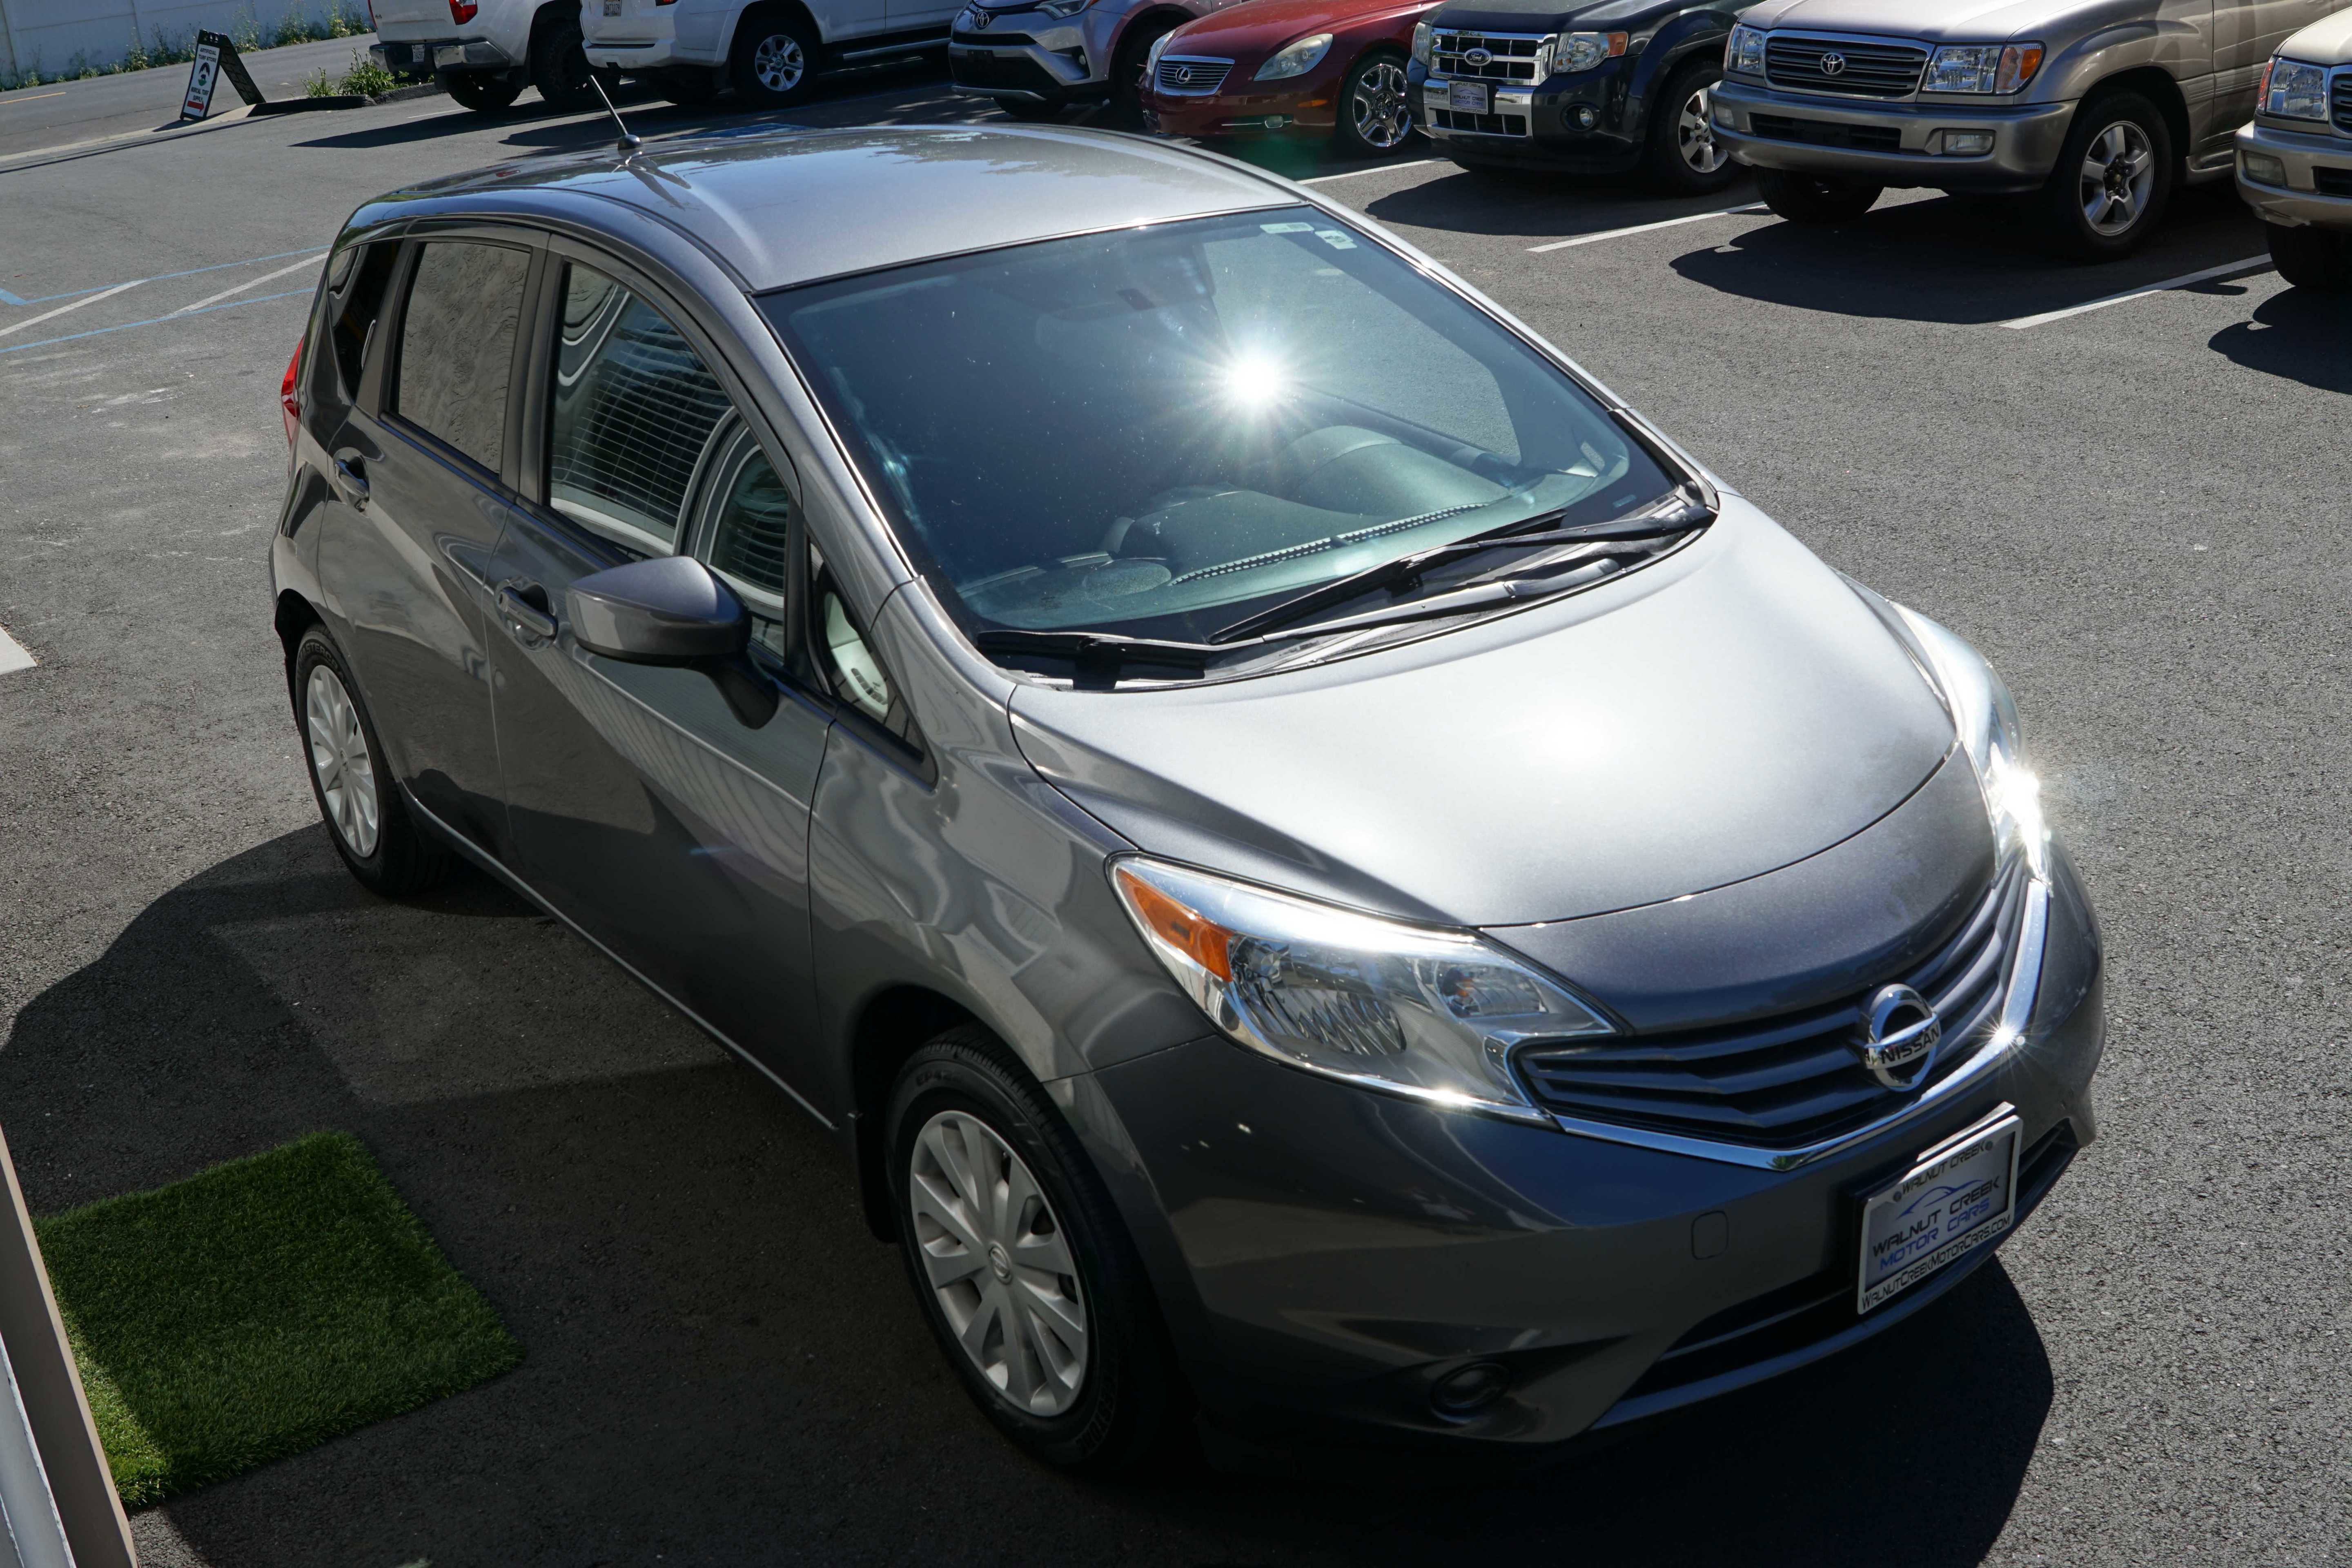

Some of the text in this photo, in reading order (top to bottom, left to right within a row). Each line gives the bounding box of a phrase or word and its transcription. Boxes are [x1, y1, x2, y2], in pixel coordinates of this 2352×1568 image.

[1470, 53, 1482, 61] Ford
[1880, 1024, 1939, 1064] NISSAN
[1902, 1139, 1986, 1195] WALNUT CREEK
[1872, 1175, 2000, 1257] WALNUT CREEK
[1880, 1198, 1990, 1271] MOTOR CARS
